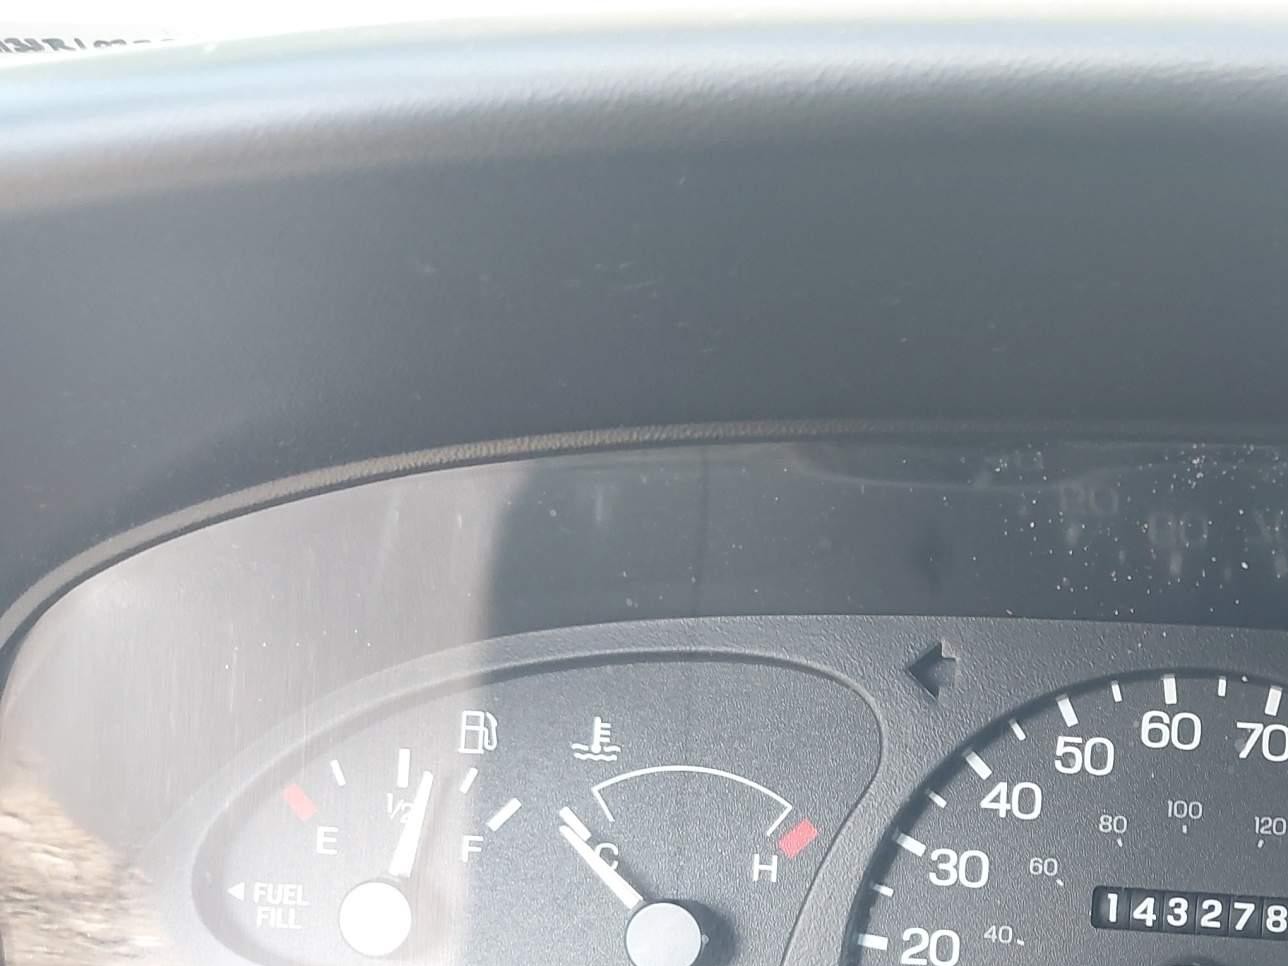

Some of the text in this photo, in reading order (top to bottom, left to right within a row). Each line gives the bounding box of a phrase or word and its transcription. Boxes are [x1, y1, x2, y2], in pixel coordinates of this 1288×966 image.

[1141, 711, 1201, 750] 60
[1055, 736, 1114, 775] 50
[980, 782, 1041, 819] 40
[1168, 800, 1202, 819] 100
[1099, 815, 1127, 833] 80
[1255, 817, 1286, 835] 120
[316, 826, 338, 855] E
[460, 833, 483, 862] F
[593, 842, 619, 872] C
[752, 854, 777, 882] H
[929, 849, 989, 888] 30
[1030, 857, 1057, 876] 60
[253, 884, 310, 906] FUEL
[256, 907, 303, 929] FILL
[1108, 894, 1287, 932] 143278
[900, 927, 960, 966] 20
[984, 925, 1012, 943] 40
